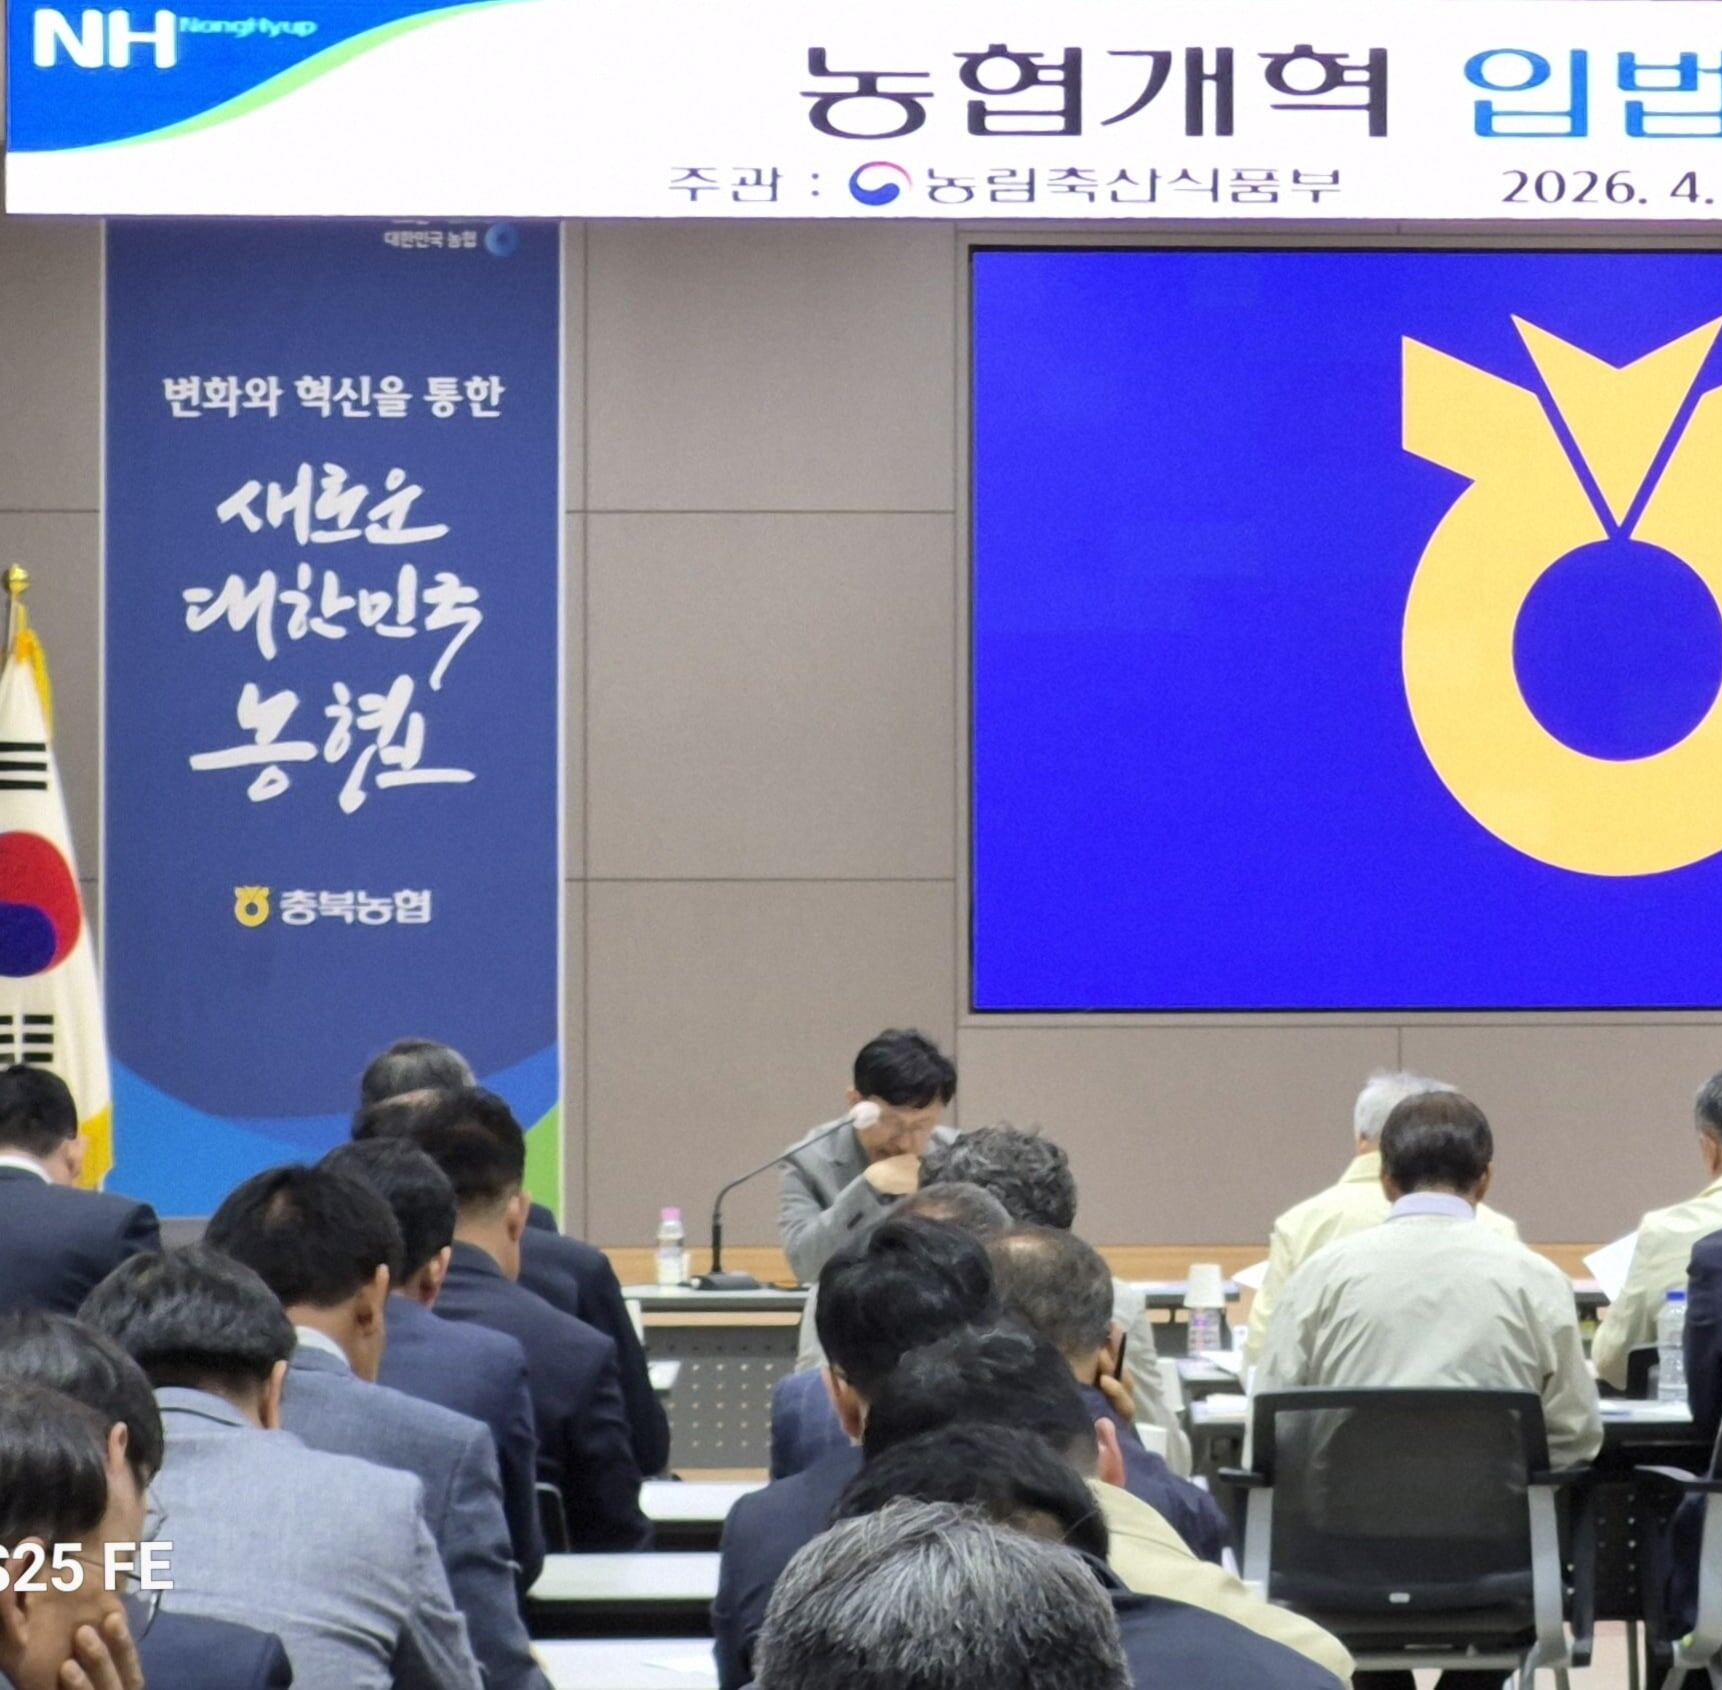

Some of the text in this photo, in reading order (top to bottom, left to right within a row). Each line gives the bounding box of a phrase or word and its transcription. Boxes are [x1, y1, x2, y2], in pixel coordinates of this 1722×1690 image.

[34, 8, 318, 69] NH NongHyup
[800, 43, 1388, 140] 농협개혁
[668, 167, 783, 202] 주관
[927, 166, 1342, 204] 농림축산식품부
[1501, 169, 1648, 205] 2026.
[1670, 170, 1715, 205] 4.
[163, 374, 506, 418] 변화와 혁신을 통한
[216, 462, 450, 546] 새로운
[182, 562, 483, 691] 대한민국
[189, 673, 476, 814] 농협
[279, 887, 433, 926] 충북농협
